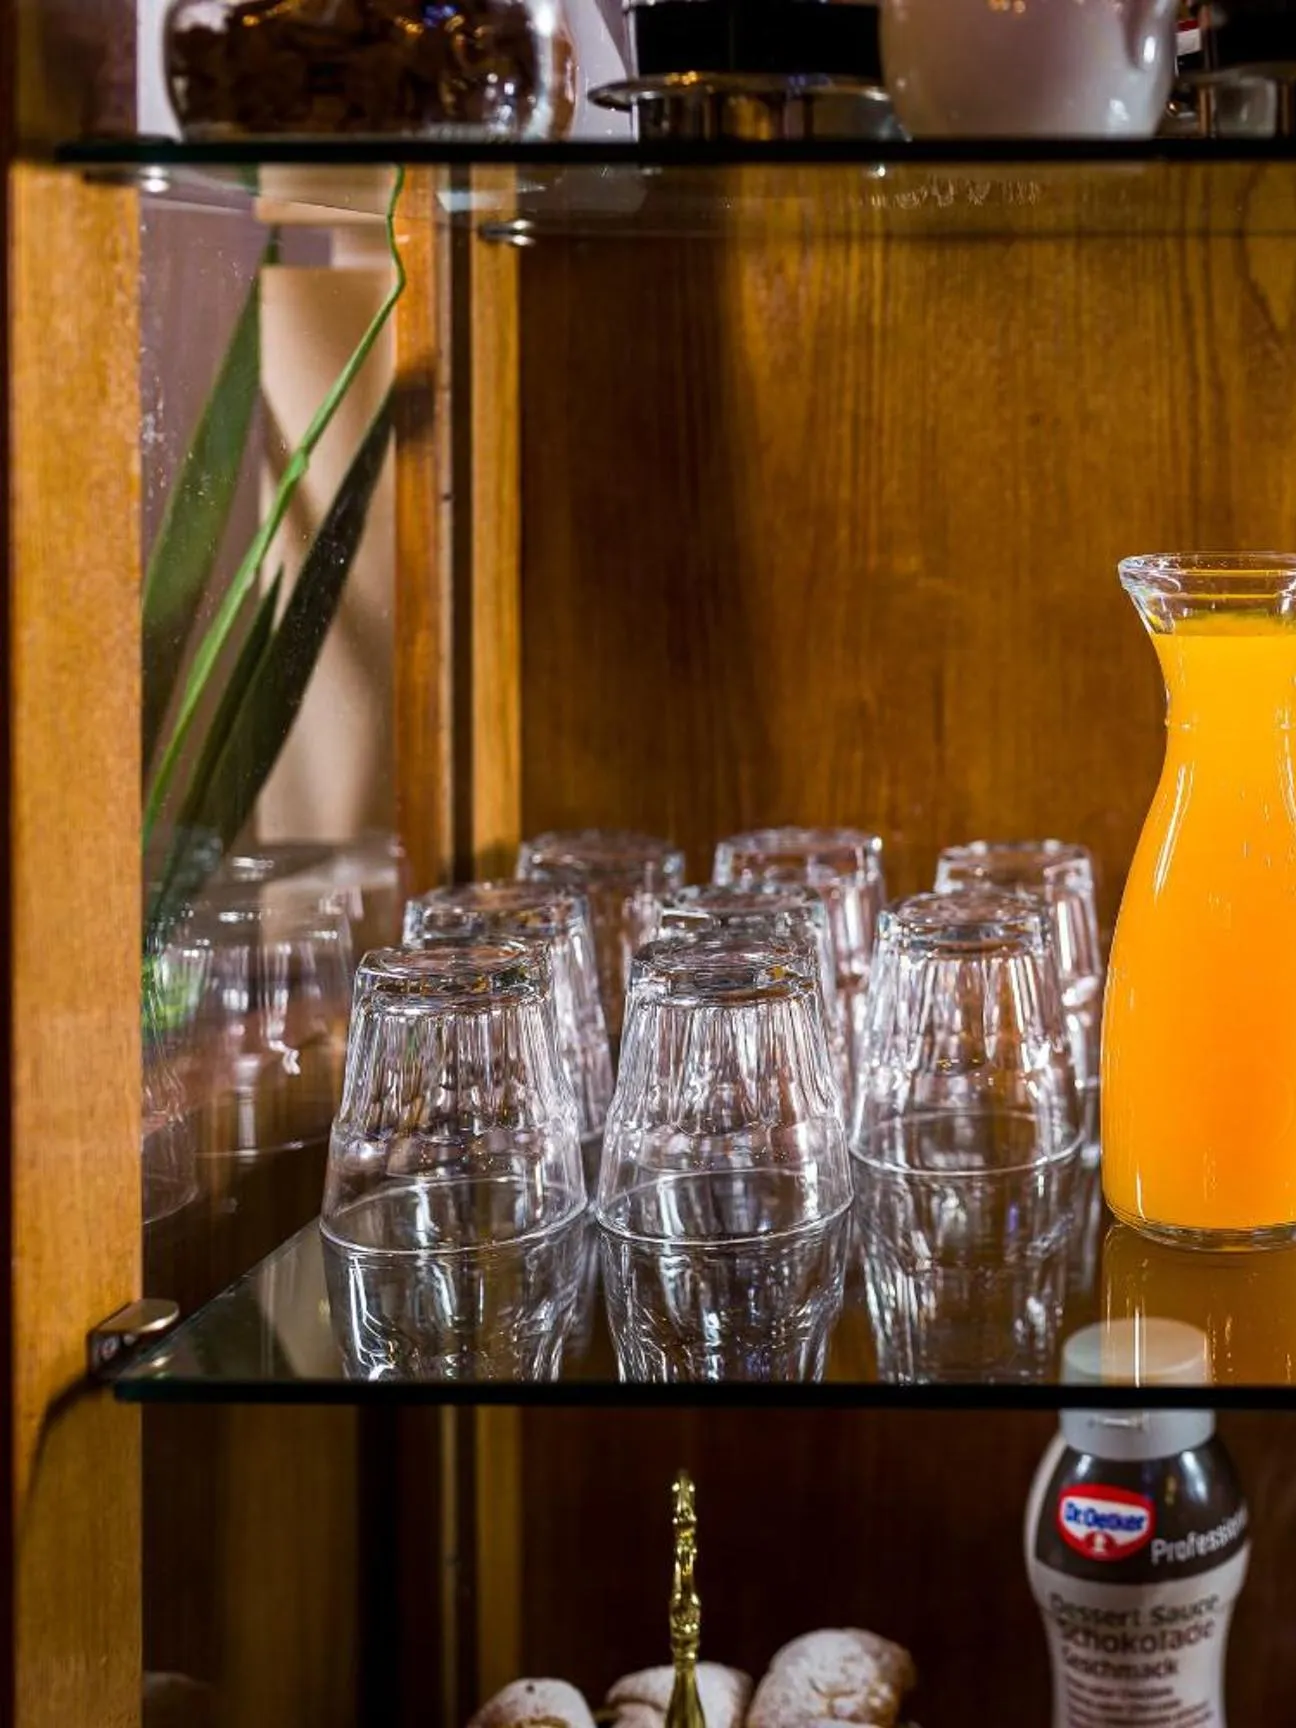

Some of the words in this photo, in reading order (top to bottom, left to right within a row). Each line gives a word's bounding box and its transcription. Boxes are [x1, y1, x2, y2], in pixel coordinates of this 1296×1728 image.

[1084, 1507, 1144, 1530] Oetker
[1051, 1593, 1138, 1623] Dessert
[1152, 1593, 1217, 1622] Sauce
[1058, 1618, 1213, 1653] Schokolade
